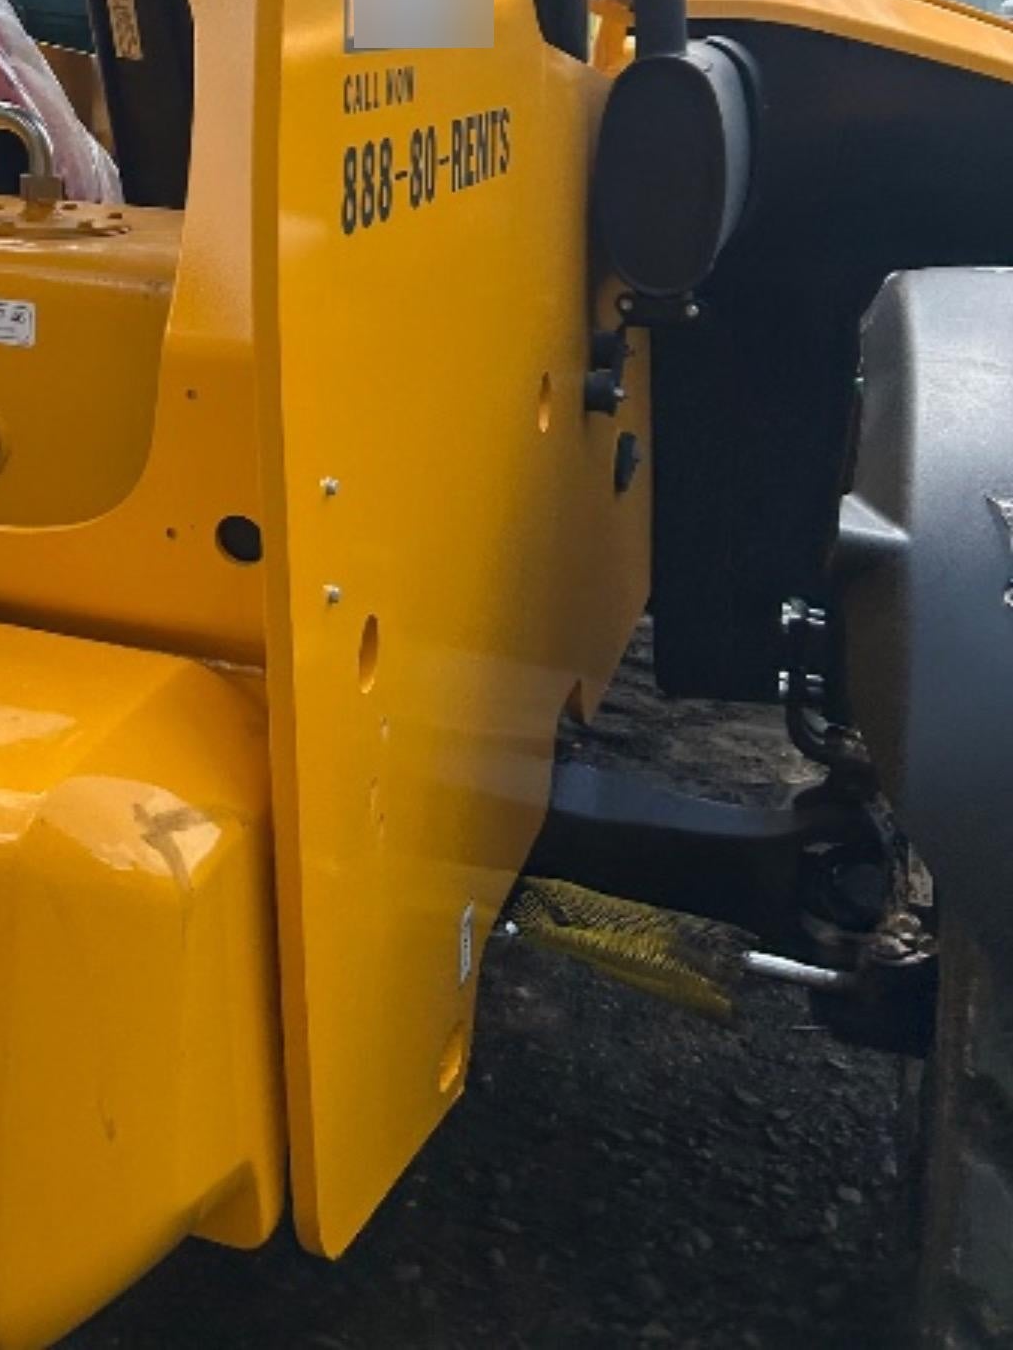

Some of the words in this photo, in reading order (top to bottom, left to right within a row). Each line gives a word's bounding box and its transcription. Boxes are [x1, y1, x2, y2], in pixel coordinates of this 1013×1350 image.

[343, 71, 380, 114] CALL
[385, 65, 415, 107] NOW
[341, 107, 511, 236] 888-80-RENTS
